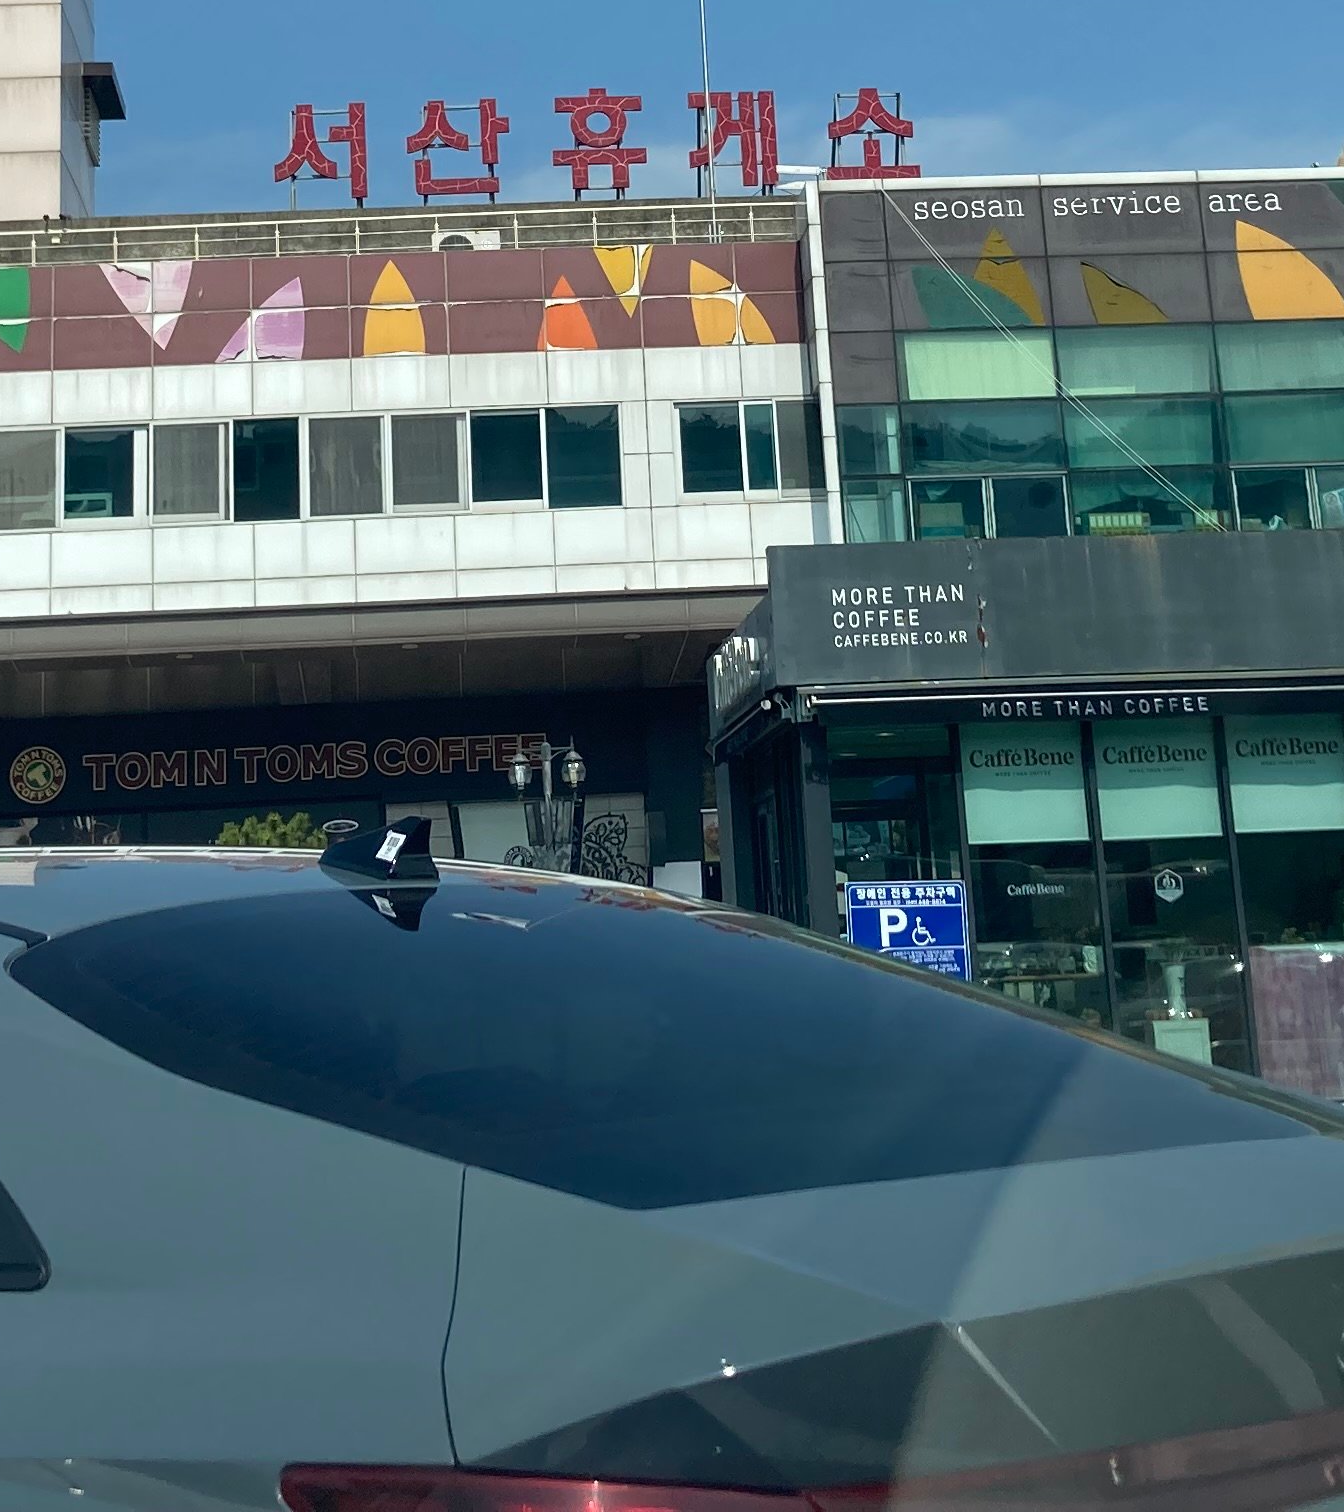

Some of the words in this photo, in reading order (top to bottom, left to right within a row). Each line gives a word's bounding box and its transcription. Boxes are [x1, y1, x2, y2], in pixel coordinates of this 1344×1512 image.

[913, 194, 1025, 220] seosan
[1052, 190, 1182, 217] service
[1207, 191, 1283, 214] area
[831, 586, 894, 607] MORE
[903, 584, 965, 604] THAN
[832, 608, 920, 630] COFFEE
[834, 630, 968, 649] CAFFEBENE.CO.KR
[981, 700, 1044, 718] MORE
[1052, 699, 1114, 717] THAN
[1123, 696, 1210, 715] COFFEE
[82, 751, 188, 791] TOM
[194, 748, 227, 786] N
[234, 740, 369, 784] TOMS
[373, 733, 547, 776] COFFEE
[856, 887, 887, 900] 장애인
[890, 887, 912, 900] 전용
[914, 886, 956, 900] 주차구역
[879, 907, 908, 948] P
